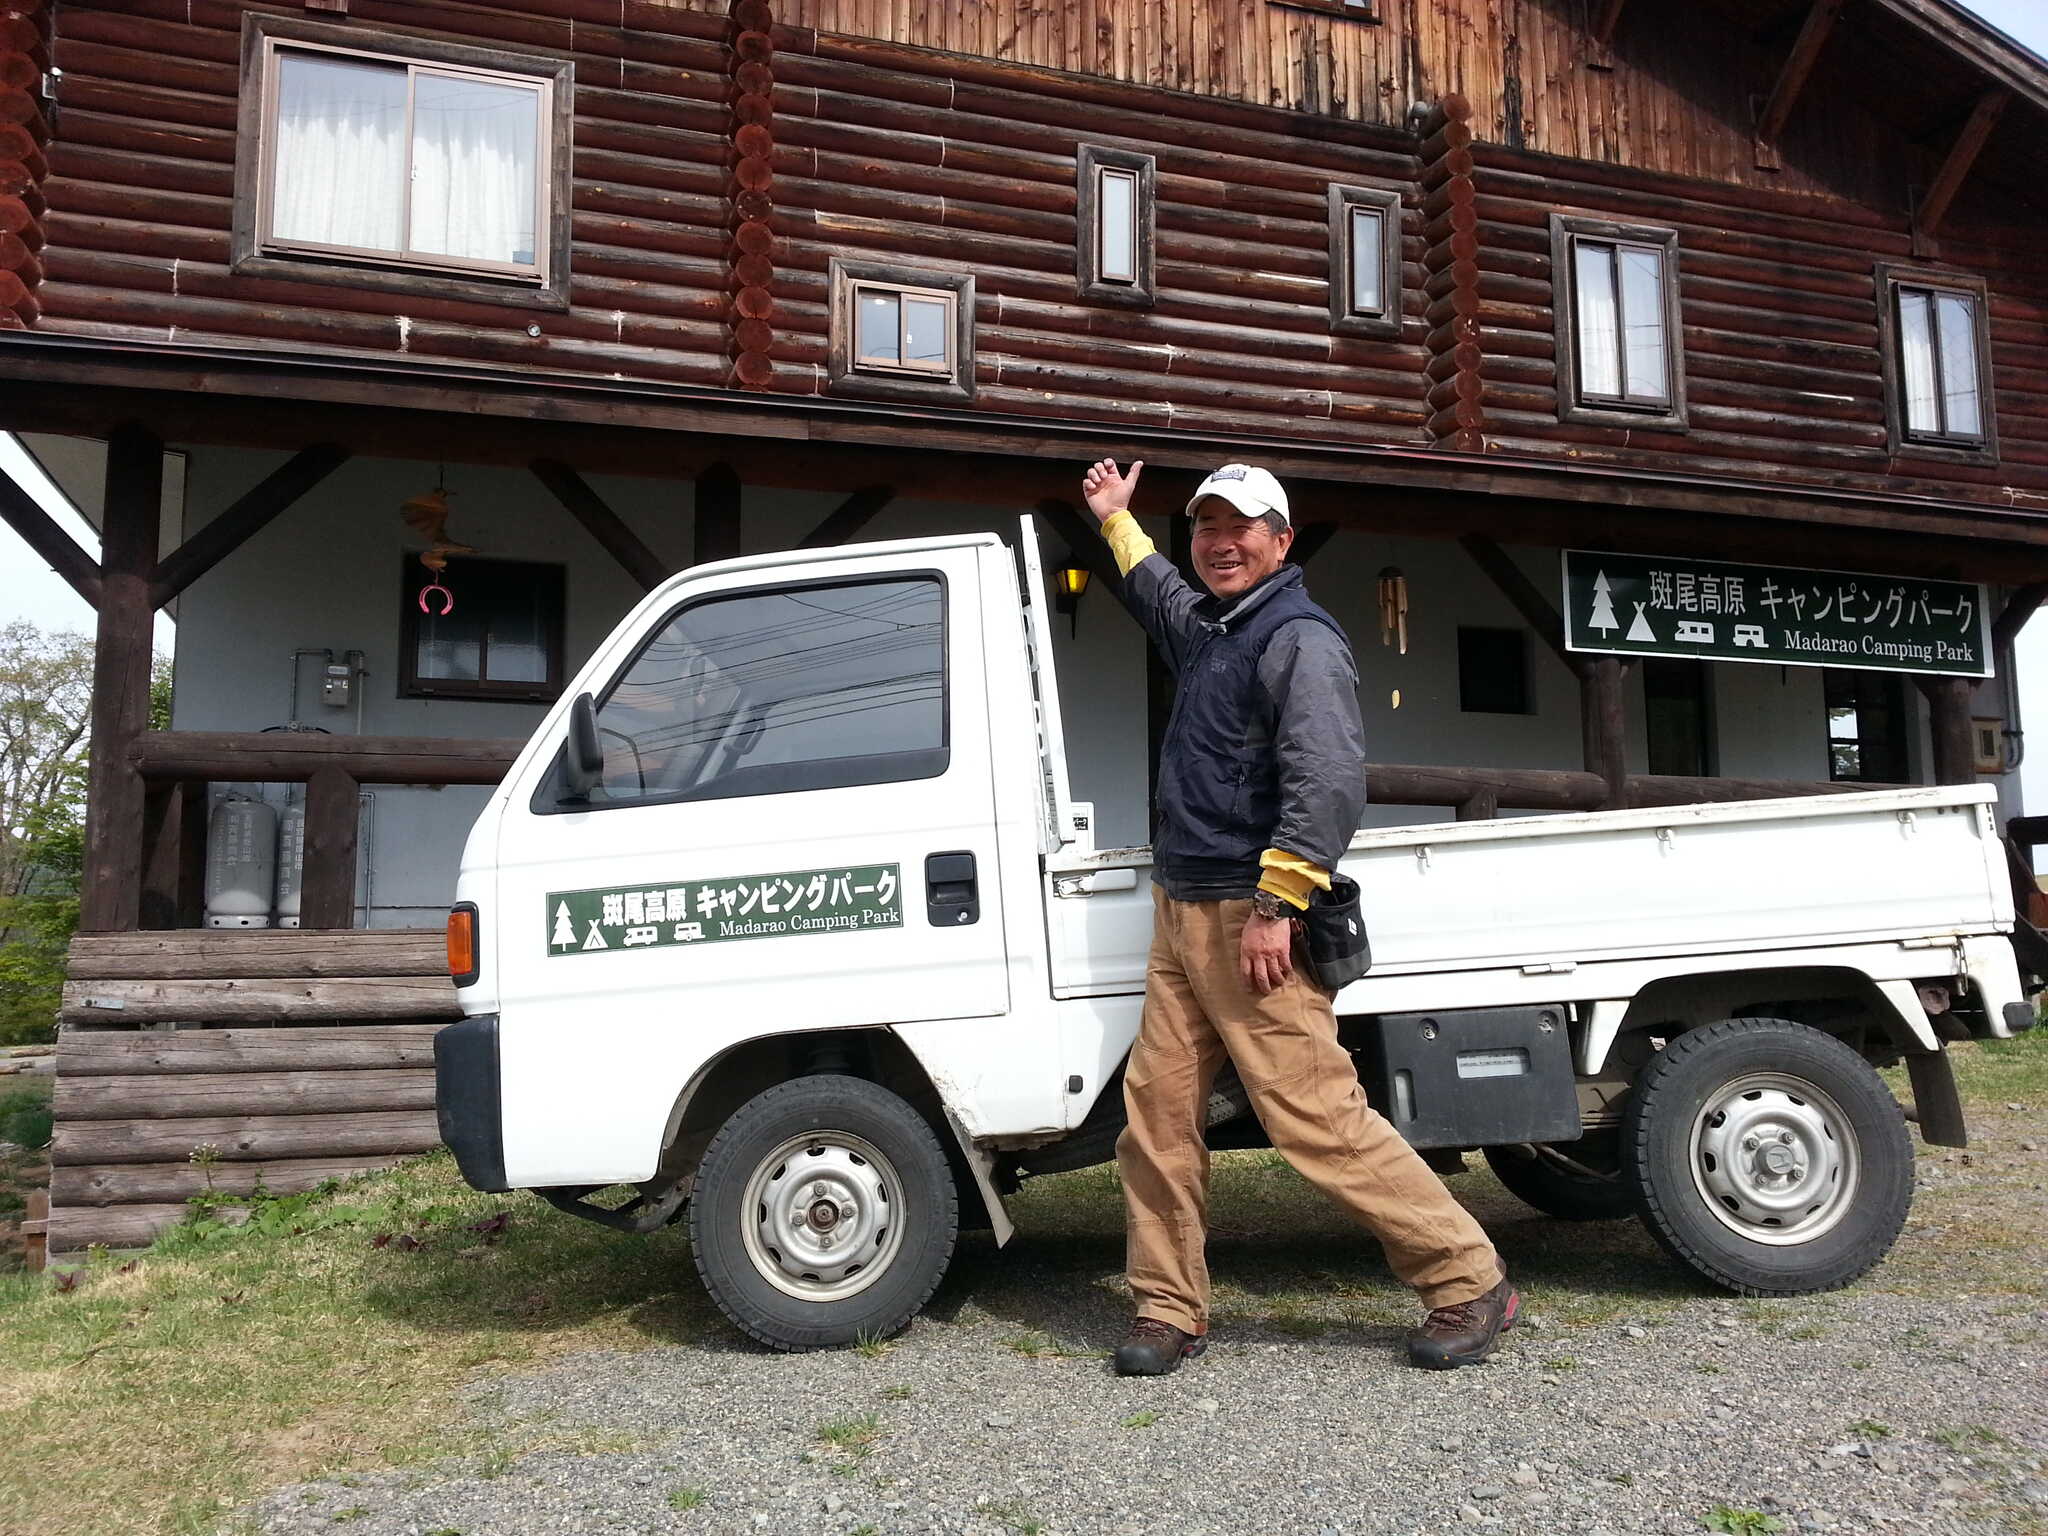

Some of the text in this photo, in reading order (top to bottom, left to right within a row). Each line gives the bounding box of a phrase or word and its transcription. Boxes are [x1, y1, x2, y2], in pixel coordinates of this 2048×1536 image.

[1648, 570, 1973, 634] 斑尾高原 キャンピングパーク
[1784, 629, 1975, 663] Madarao Camping Park
[602, 869, 896, 926] 斑尾高原 キャンピングパーク
[719, 908, 900, 937] Madarao Camping Park
